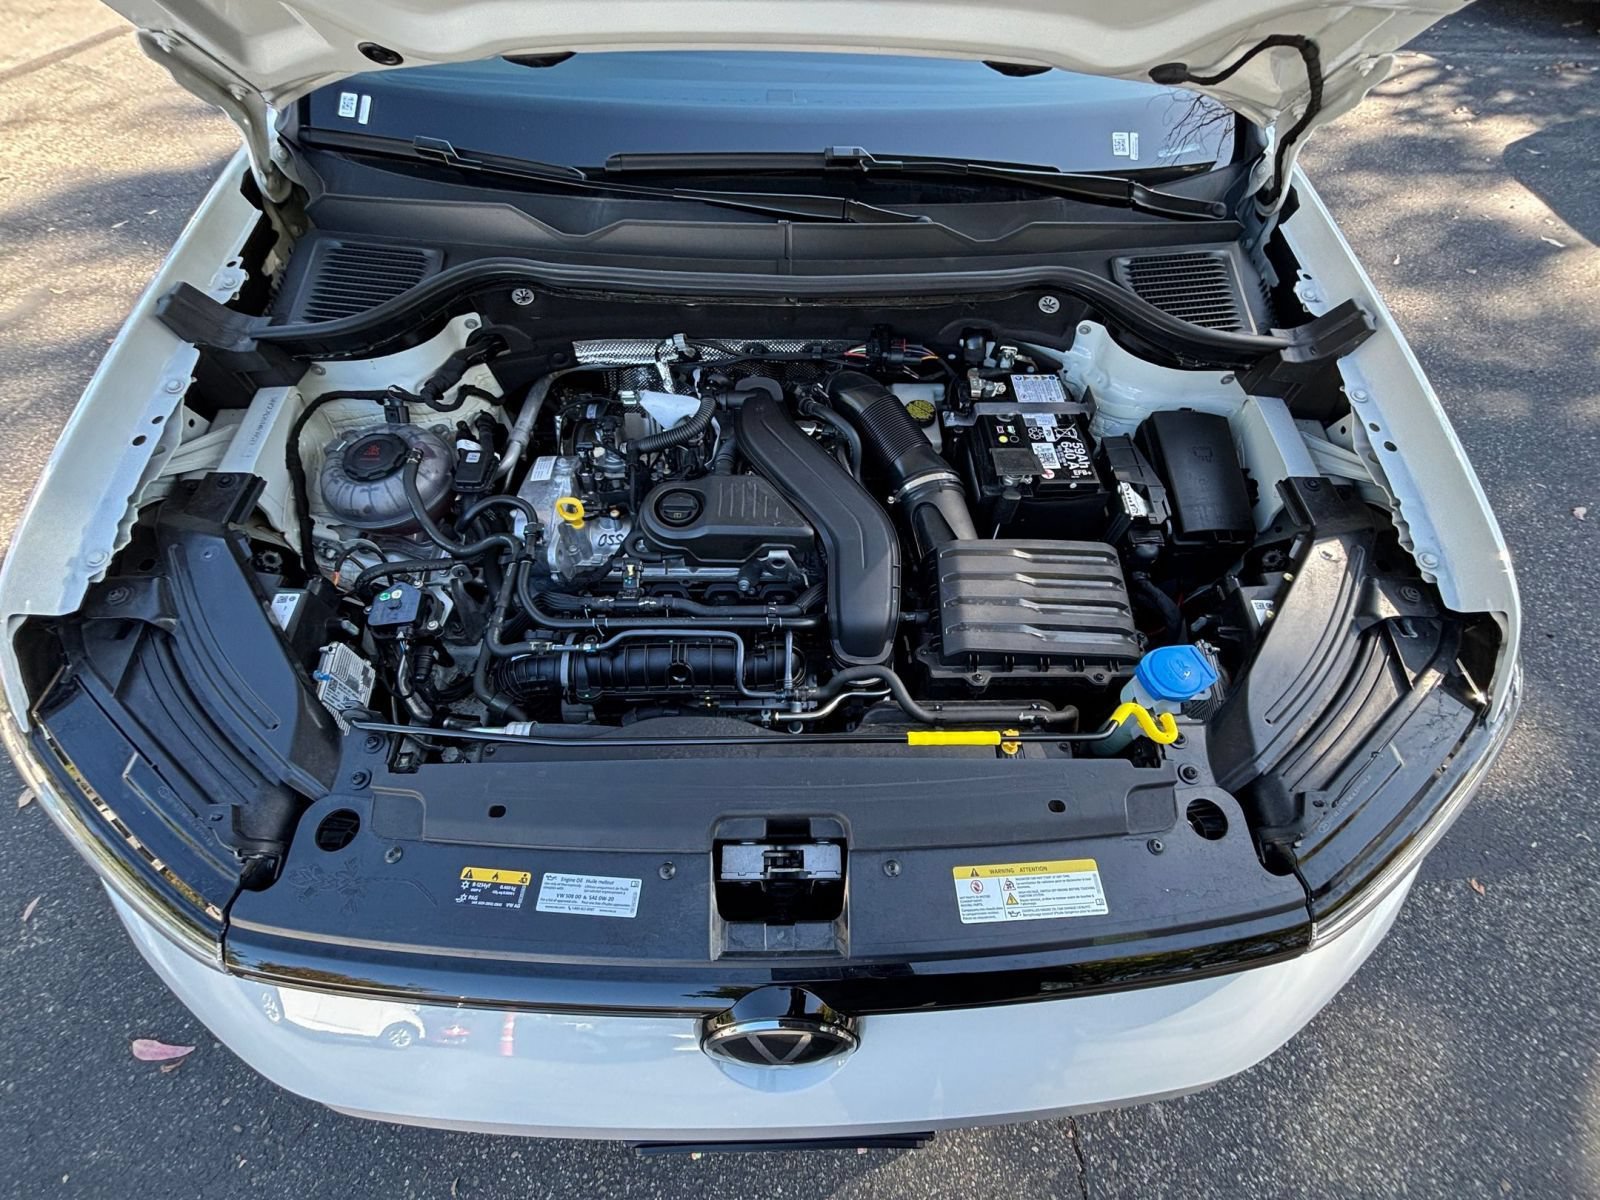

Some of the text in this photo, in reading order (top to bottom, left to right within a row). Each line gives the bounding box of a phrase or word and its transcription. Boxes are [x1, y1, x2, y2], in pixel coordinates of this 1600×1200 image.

[1061, 441, 1077, 460] 640
[1072, 442, 1090, 469] 59Ah
[1067, 461, 1080, 470] A
[1019, 865, 1048, 873] ATTENTION
